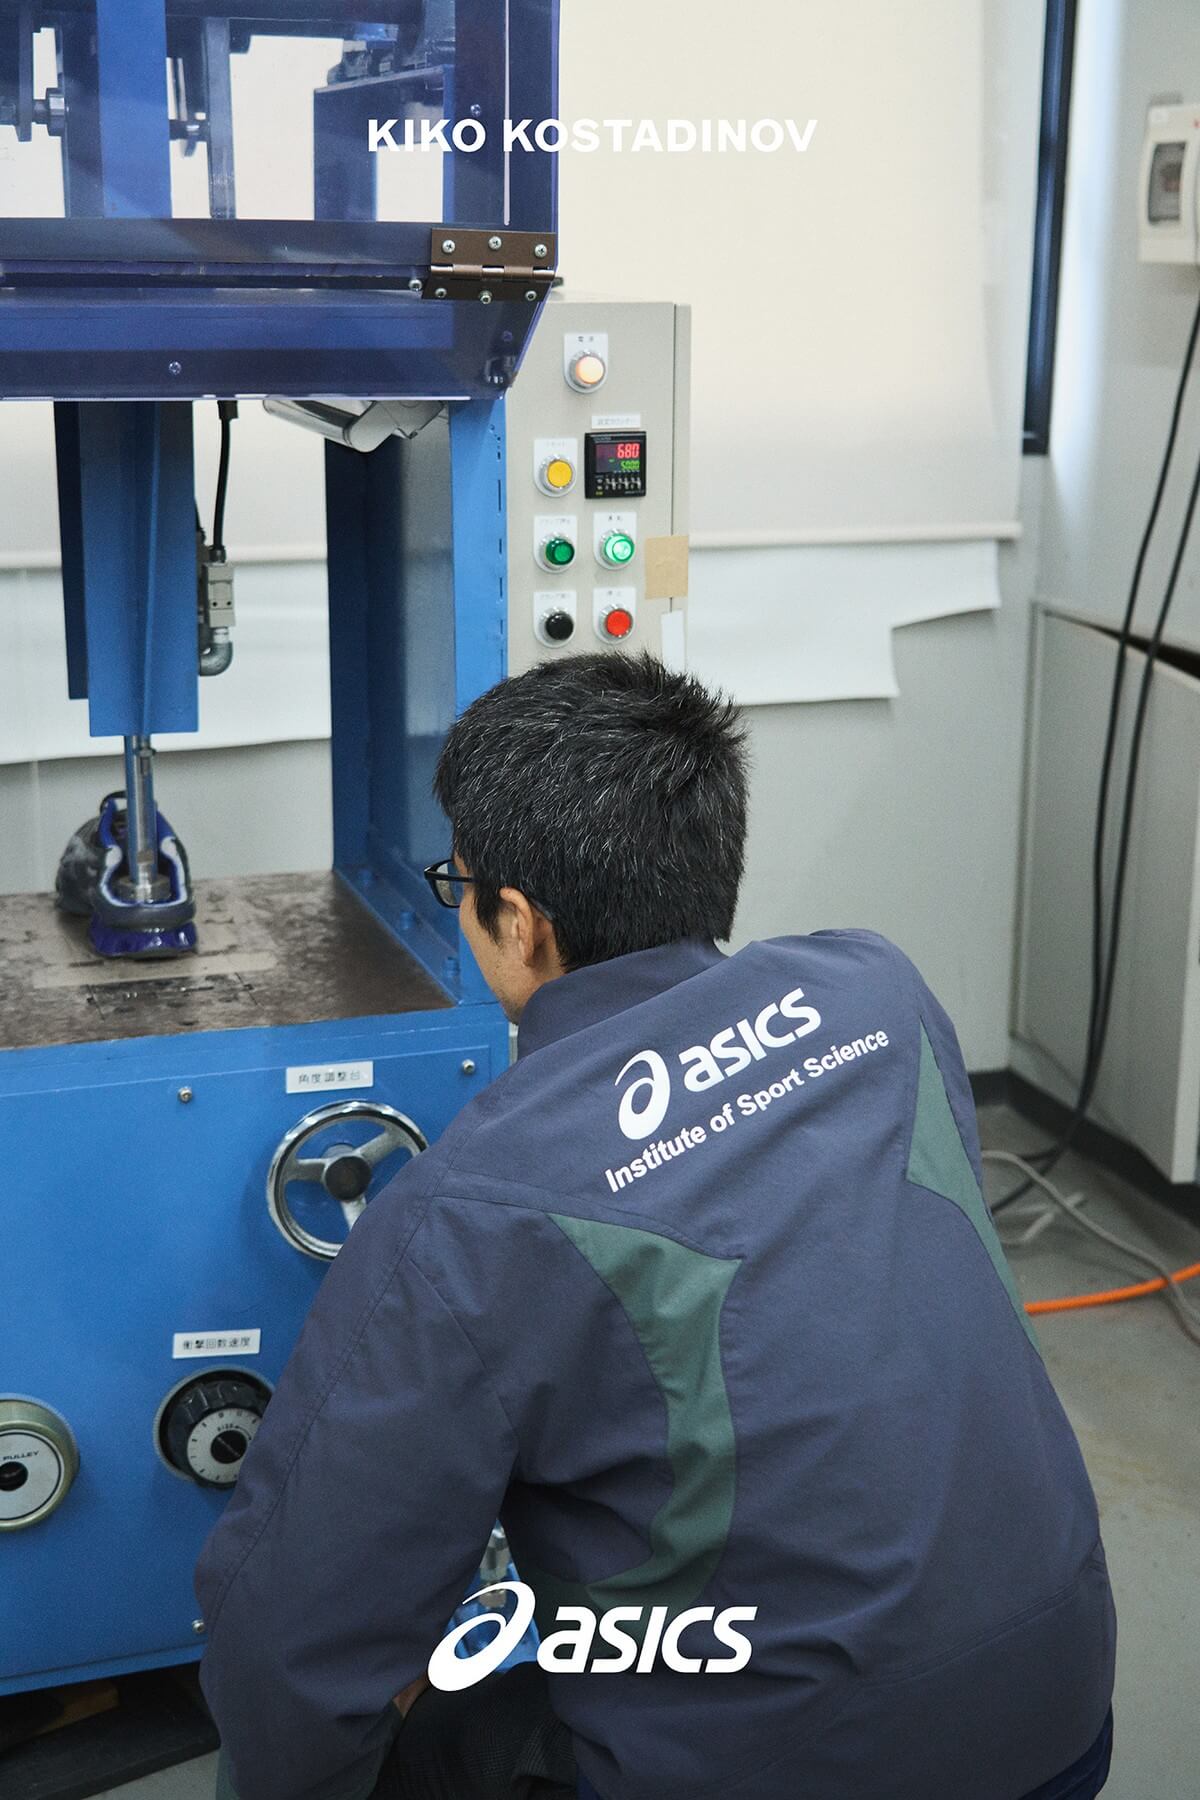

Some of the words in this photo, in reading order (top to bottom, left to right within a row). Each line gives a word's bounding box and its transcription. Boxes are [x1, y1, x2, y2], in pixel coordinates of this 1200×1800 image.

[617, 443, 640, 458] 680
[604, 1126, 707, 1193] Institute
[709, 1103, 736, 1133] of
[736, 1068, 805, 1116] Sport
[803, 1030, 889, 1078] Science
[2, 1450, 40, 1461] PULLEY
